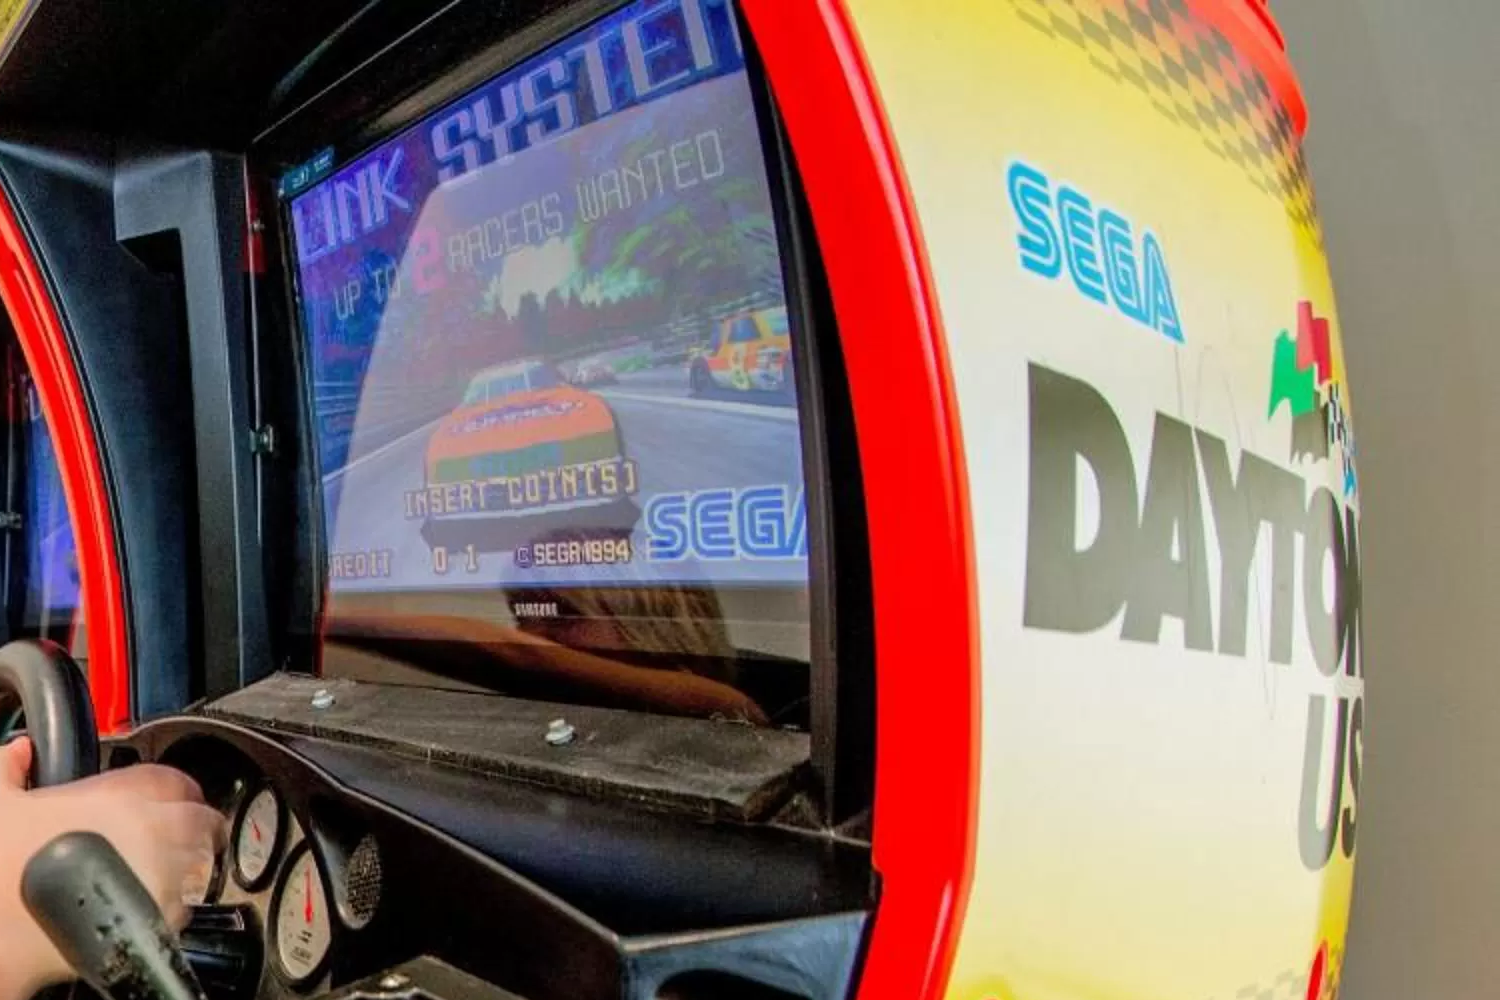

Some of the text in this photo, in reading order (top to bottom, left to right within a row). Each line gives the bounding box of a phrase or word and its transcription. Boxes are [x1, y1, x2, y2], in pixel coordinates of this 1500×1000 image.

[334, 280, 361, 321] UP
[449, 192, 565, 273] RACERS
[576, 128, 725, 223] WANTED
[1008, 161, 1186, 345] SEGA
[405, 481, 487, 517] INSERT
[328, 551, 390, 578] REDIT
